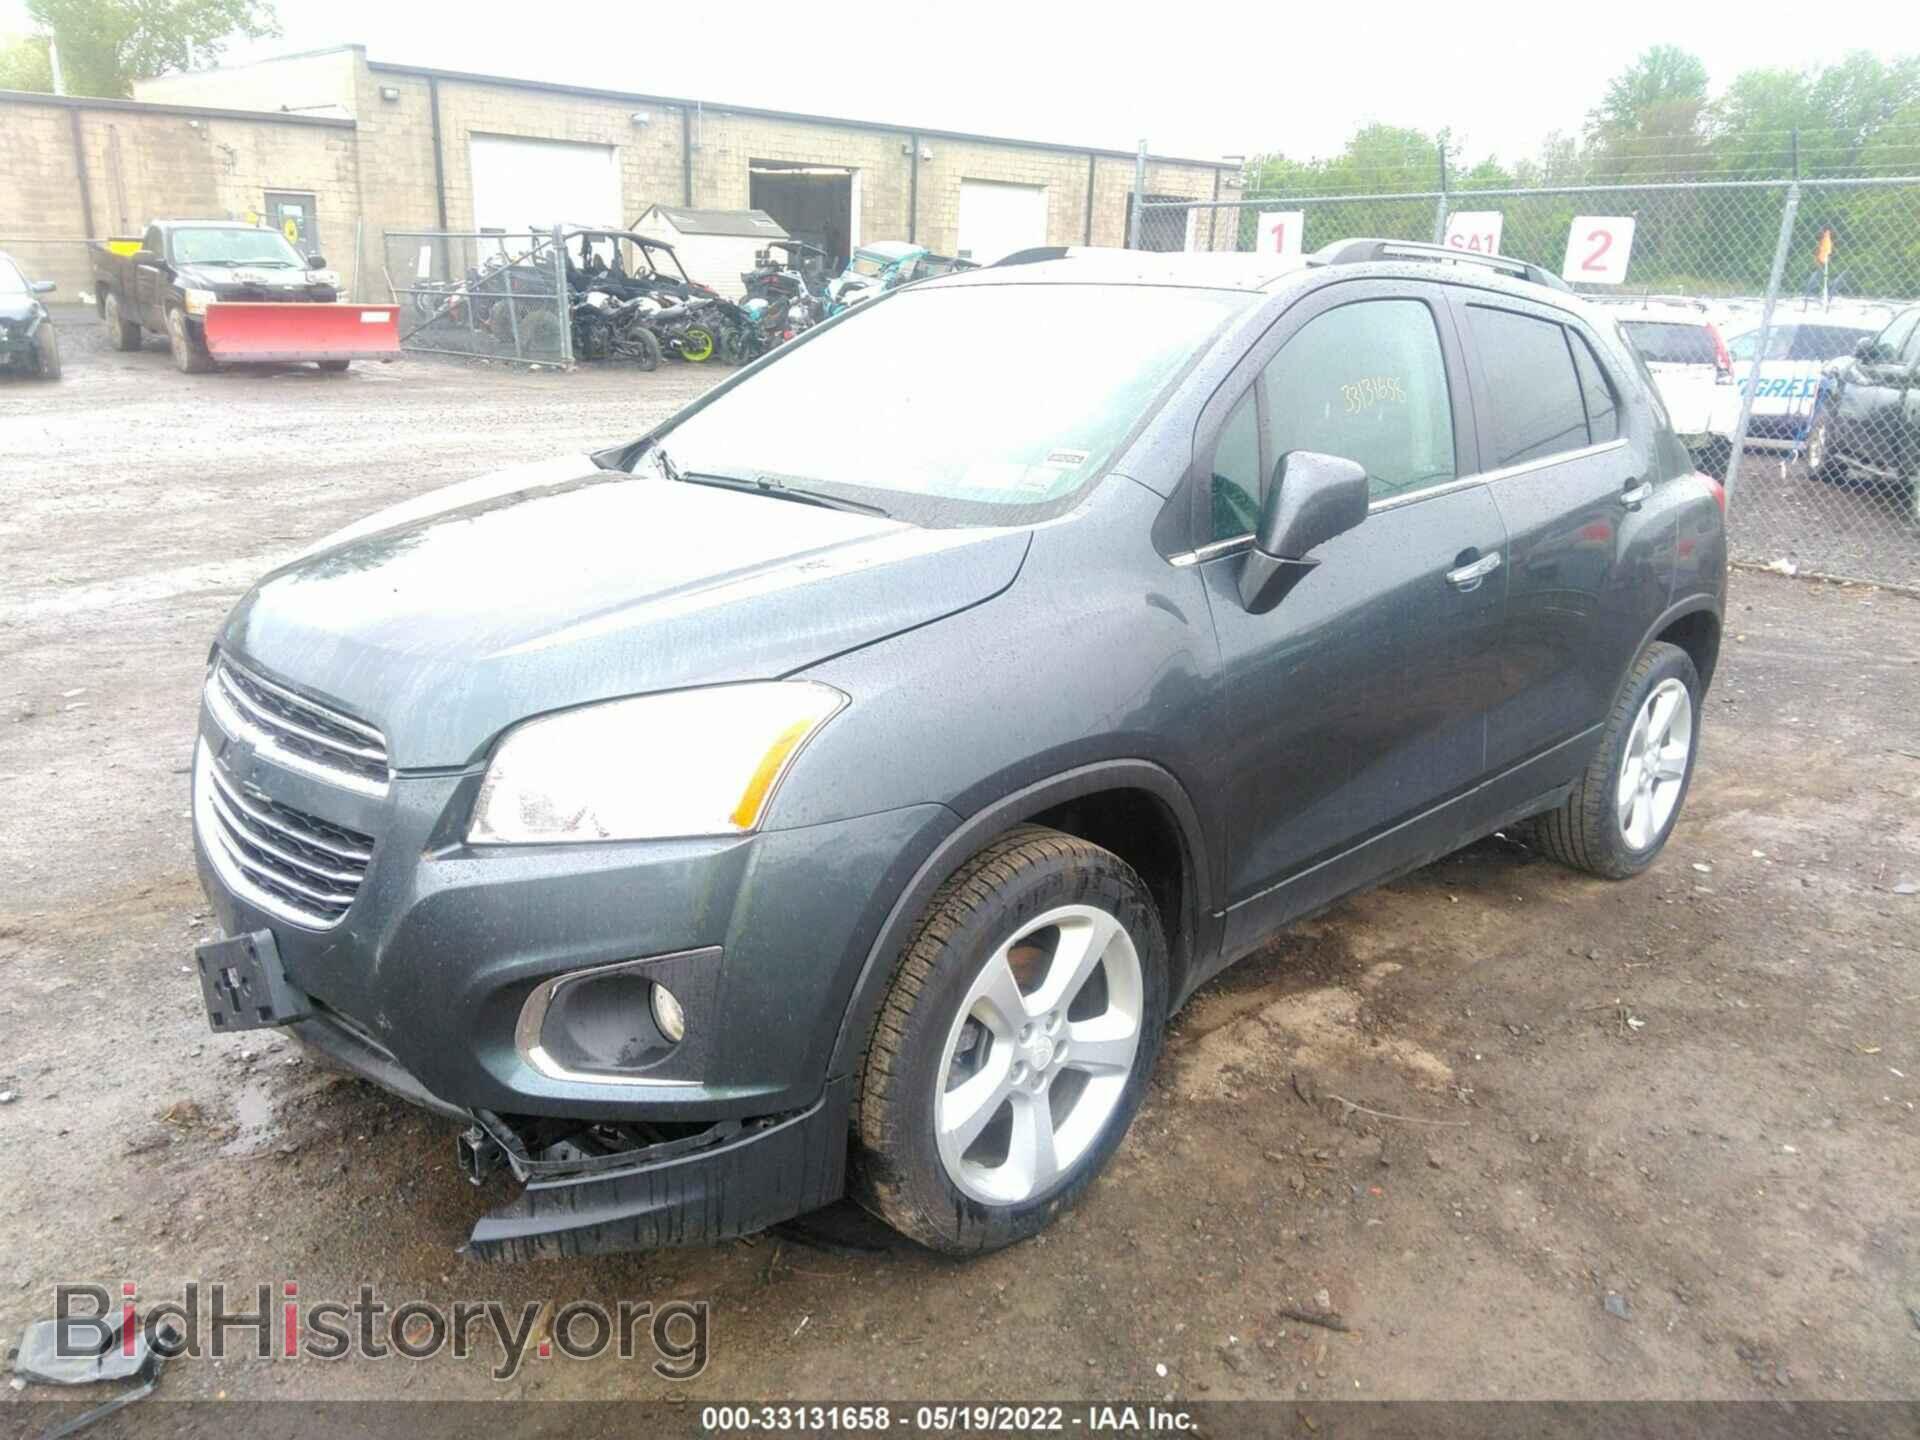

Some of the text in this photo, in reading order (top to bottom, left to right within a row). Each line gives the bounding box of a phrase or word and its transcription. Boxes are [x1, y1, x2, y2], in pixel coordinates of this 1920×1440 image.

[1272, 223, 1285, 254] 1
[1450, 233, 1494, 254] SA1
[1581, 229, 1613, 271] 2
